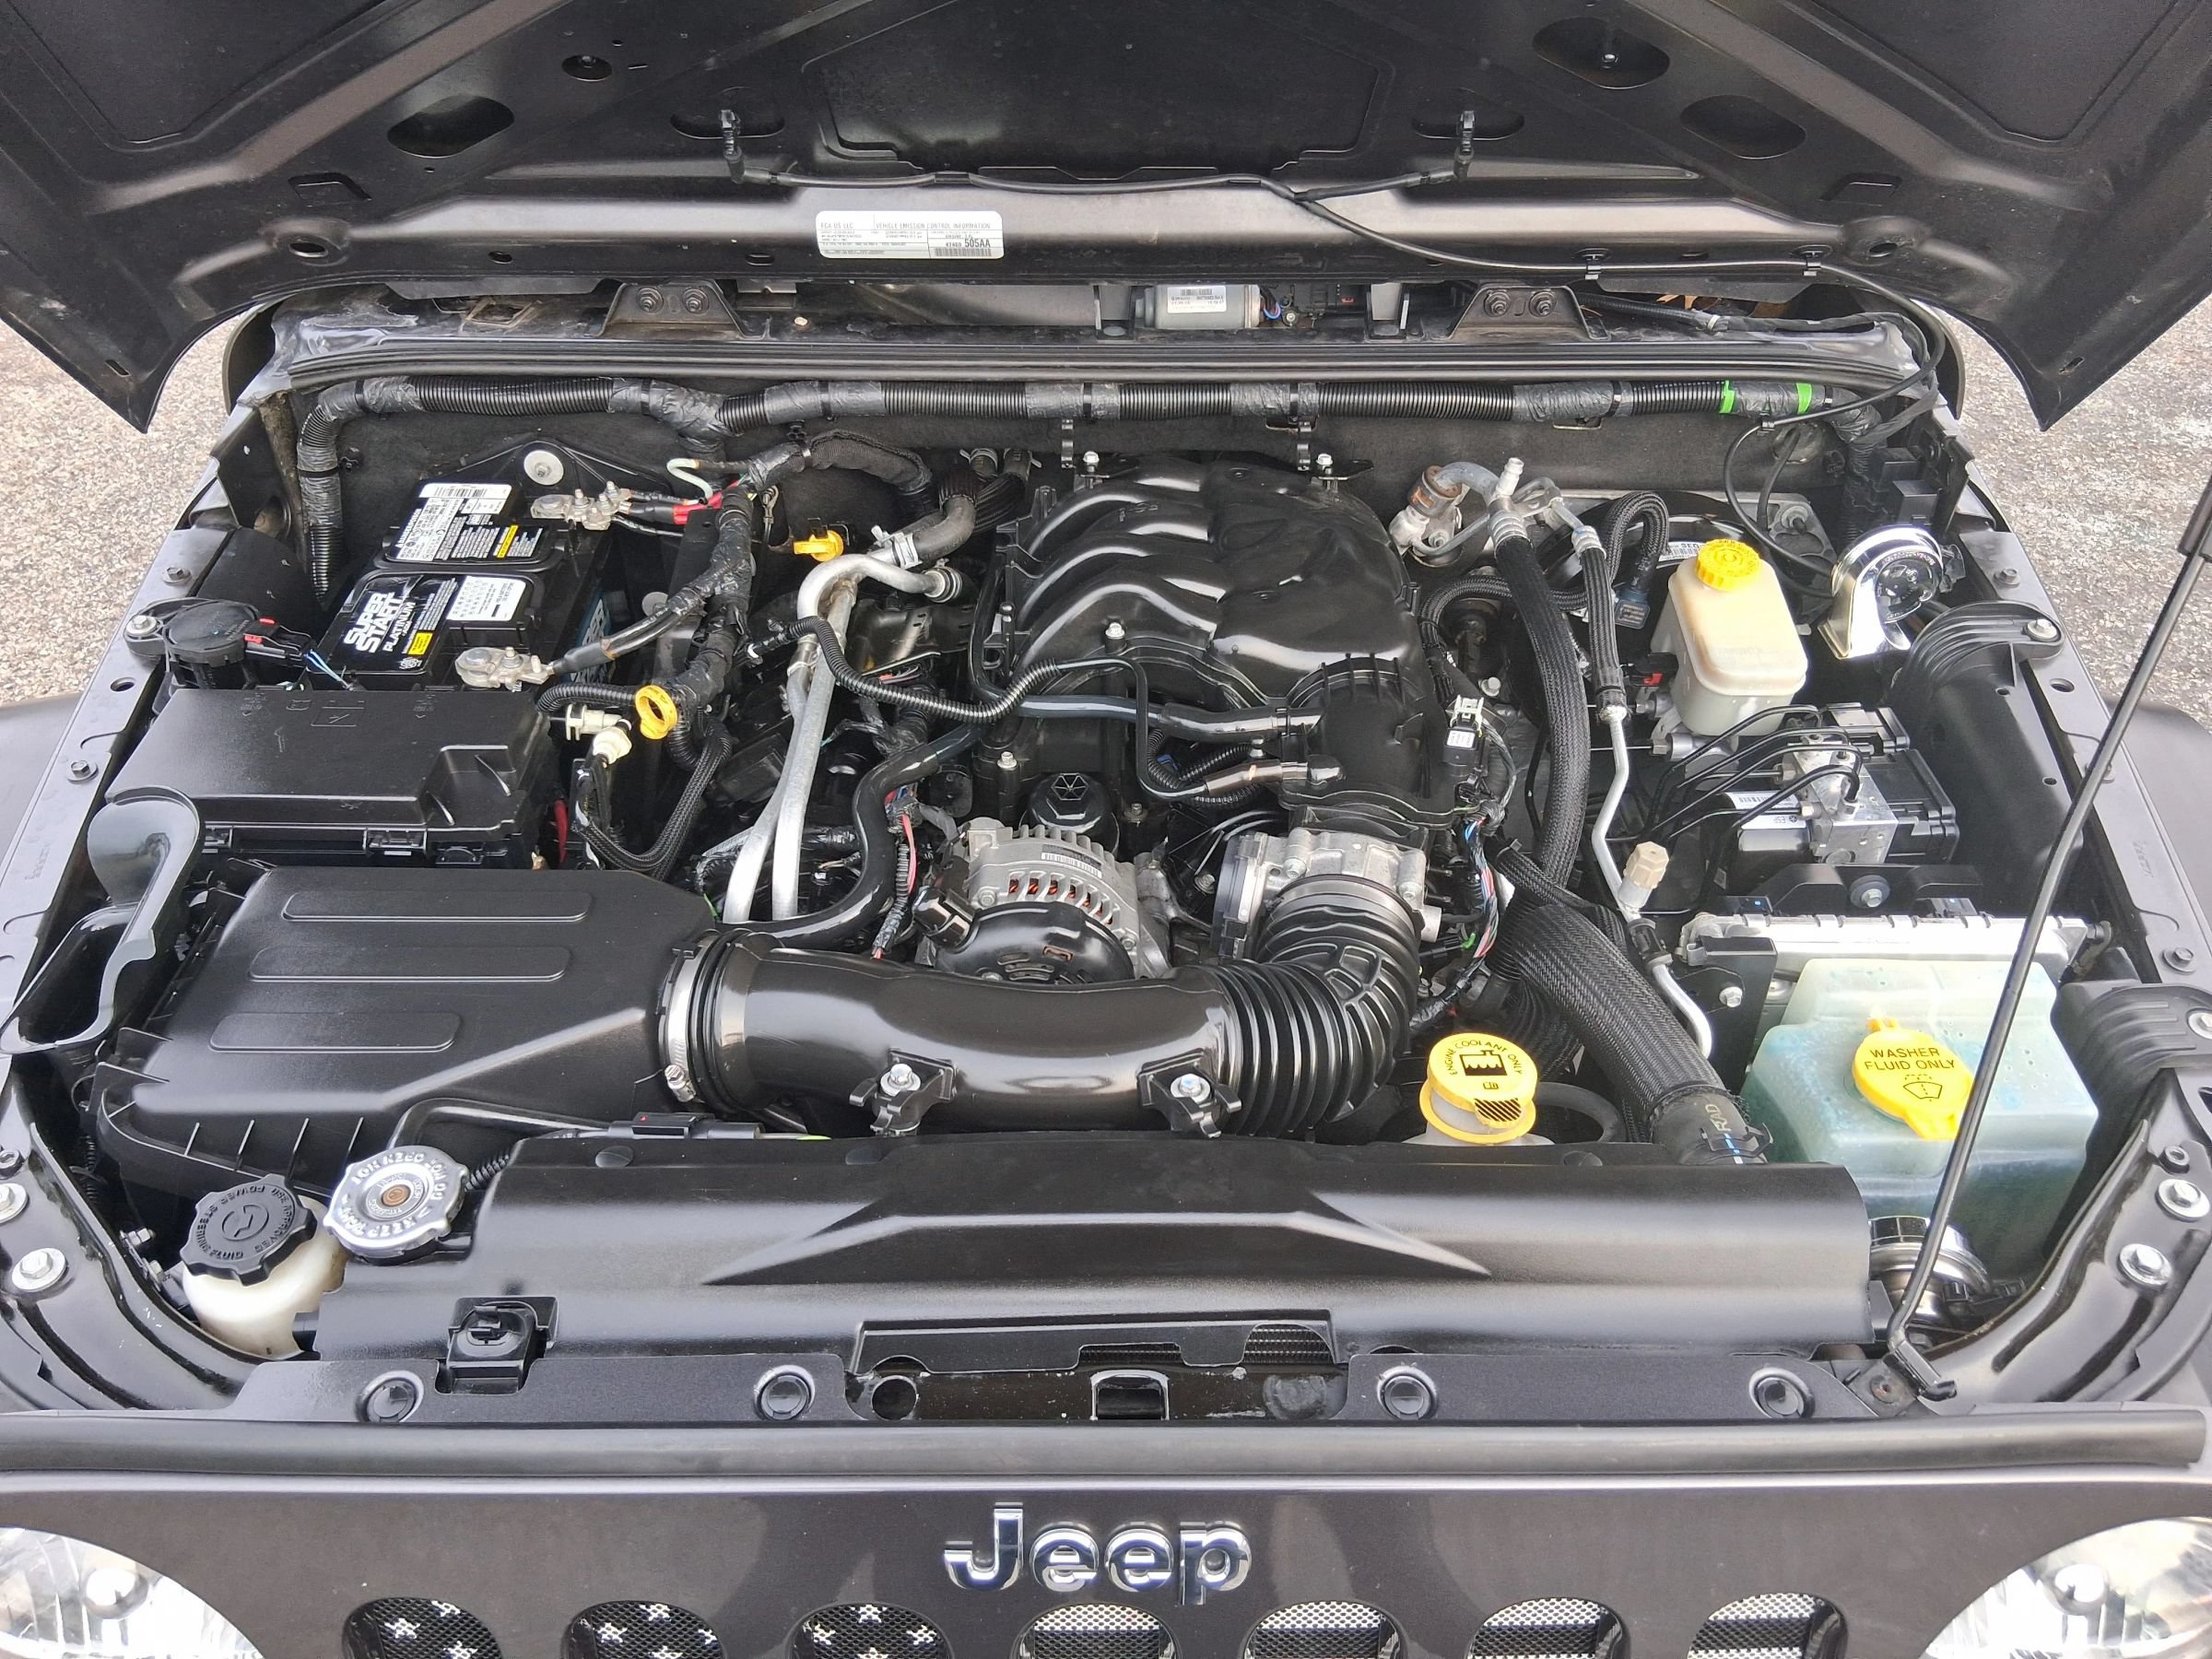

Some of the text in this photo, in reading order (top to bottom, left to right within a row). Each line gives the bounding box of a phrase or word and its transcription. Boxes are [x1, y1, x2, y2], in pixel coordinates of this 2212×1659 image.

[964, 238, 991, 248] 505AA
[344, 592, 388, 645] SUPER
[355, 592, 395, 653] START
[382, 602, 418, 652] PLATINUM
[1444, 1039, 1524, 1076] ENGINE COOLANT ONLY
[1865, 1059, 1955, 1071] FLUID ONLY
[1869, 1047, 1940, 1058] WASHER
[1705, 1103, 1732, 1132] RAD
[220, 1184, 265, 1206] POWER
[195, 1203, 219, 1253] STEERING
[254, 1187, 292, 1253] USE APPROVED
[368, 1216, 418, 1238] KEEP
[943, 1502, 1253, 1606] Jeep
